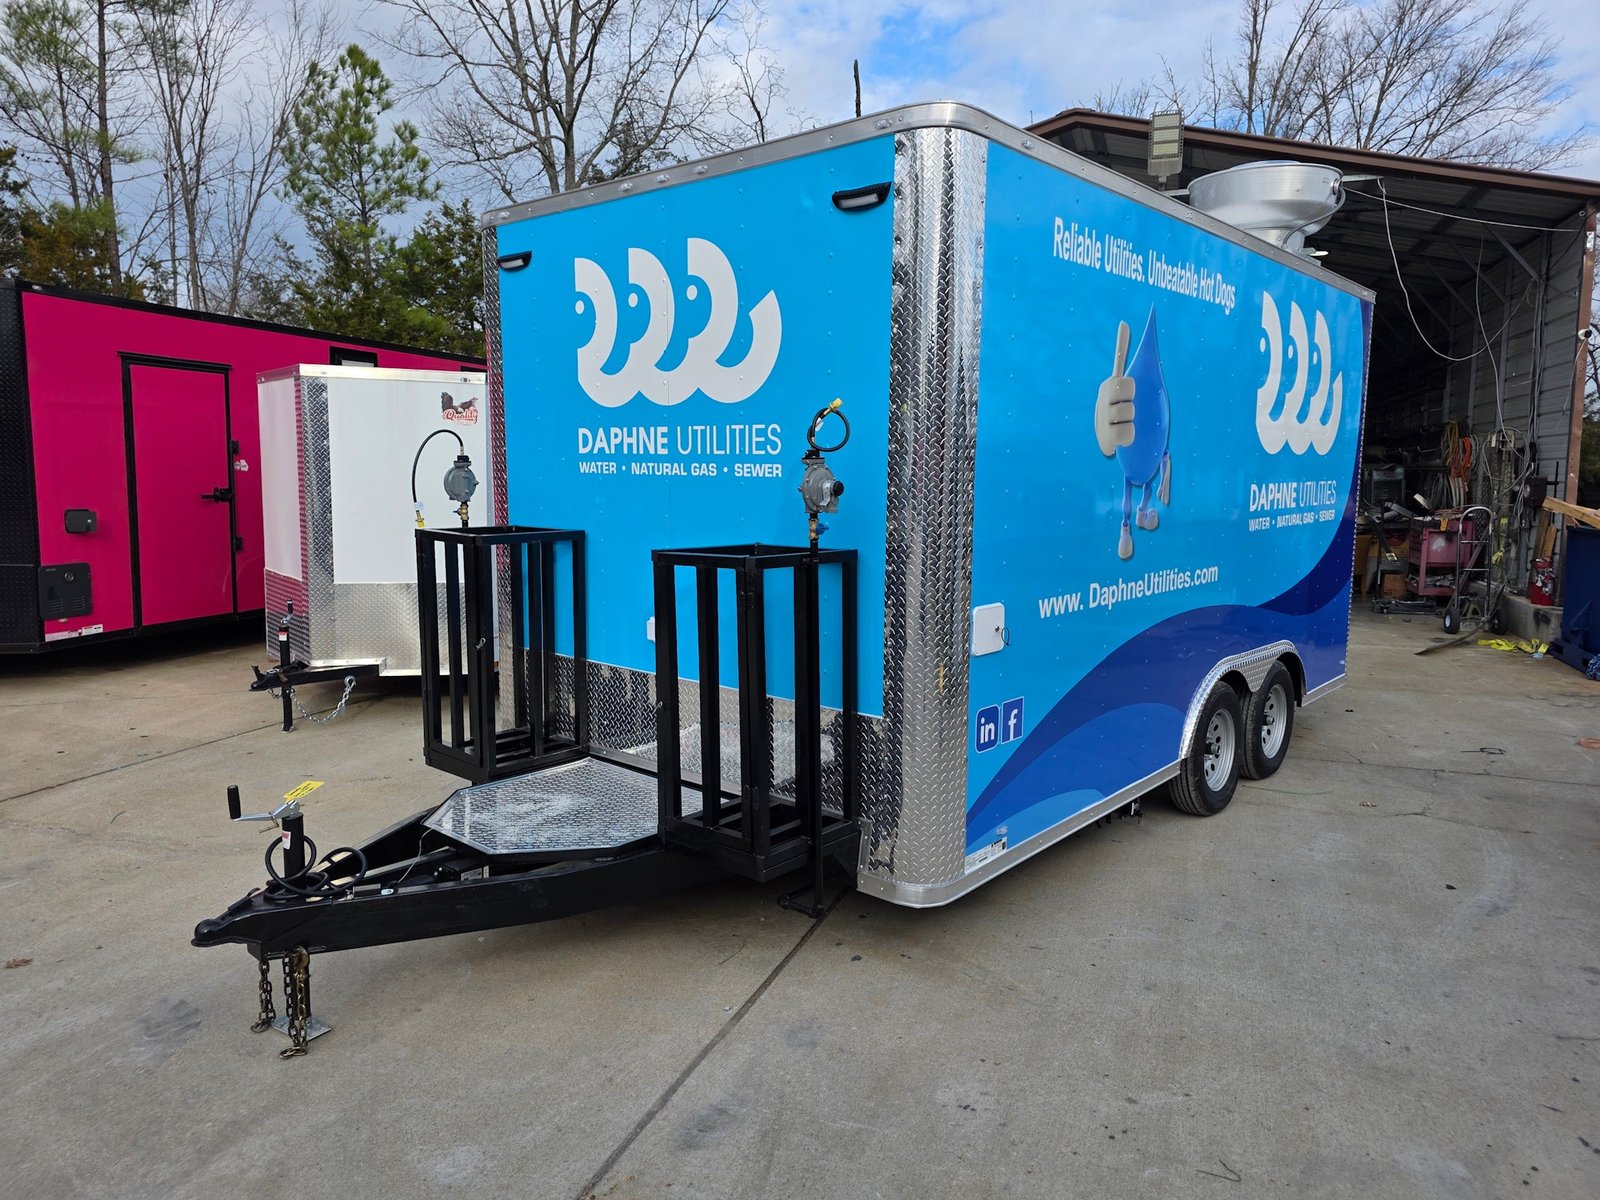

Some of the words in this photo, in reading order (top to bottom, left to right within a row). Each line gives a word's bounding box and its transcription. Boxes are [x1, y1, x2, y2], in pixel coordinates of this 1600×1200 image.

[1053, 216, 1102, 270] Reliable
[1104, 233, 1145, 282] Utilities.
[1148, 249, 1198, 298] Unbeatable
[1199, 267, 1215, 302] Hot
[1215, 272, 1236, 316] Dogs
[444, 409, 478, 424] Quality
[577, 426, 669, 455] DAPHNE
[676, 423, 782, 455] UTILITIES
[579, 461, 617, 474] WATER
[631, 462, 687, 476] NATURAL
[691, 462, 717, 477] GAS
[734, 463, 782, 478] SEWER
[1249, 482, 1298, 512] DAPHNE
[1299, 480, 1337, 508] UTILITIES
[1248, 517, 1271, 532] WATER
[1276, 513, 1303, 529] NATURAL
[1302, 511, 1315, 524] GAS
[1318, 509, 1336, 522] SEWER
[1038, 591, 1084, 619] www.
[1088, 565, 1219, 610] DaphneUtilities.com
[979, 717, 996, 744] in
[1008, 708, 1018, 742] f
